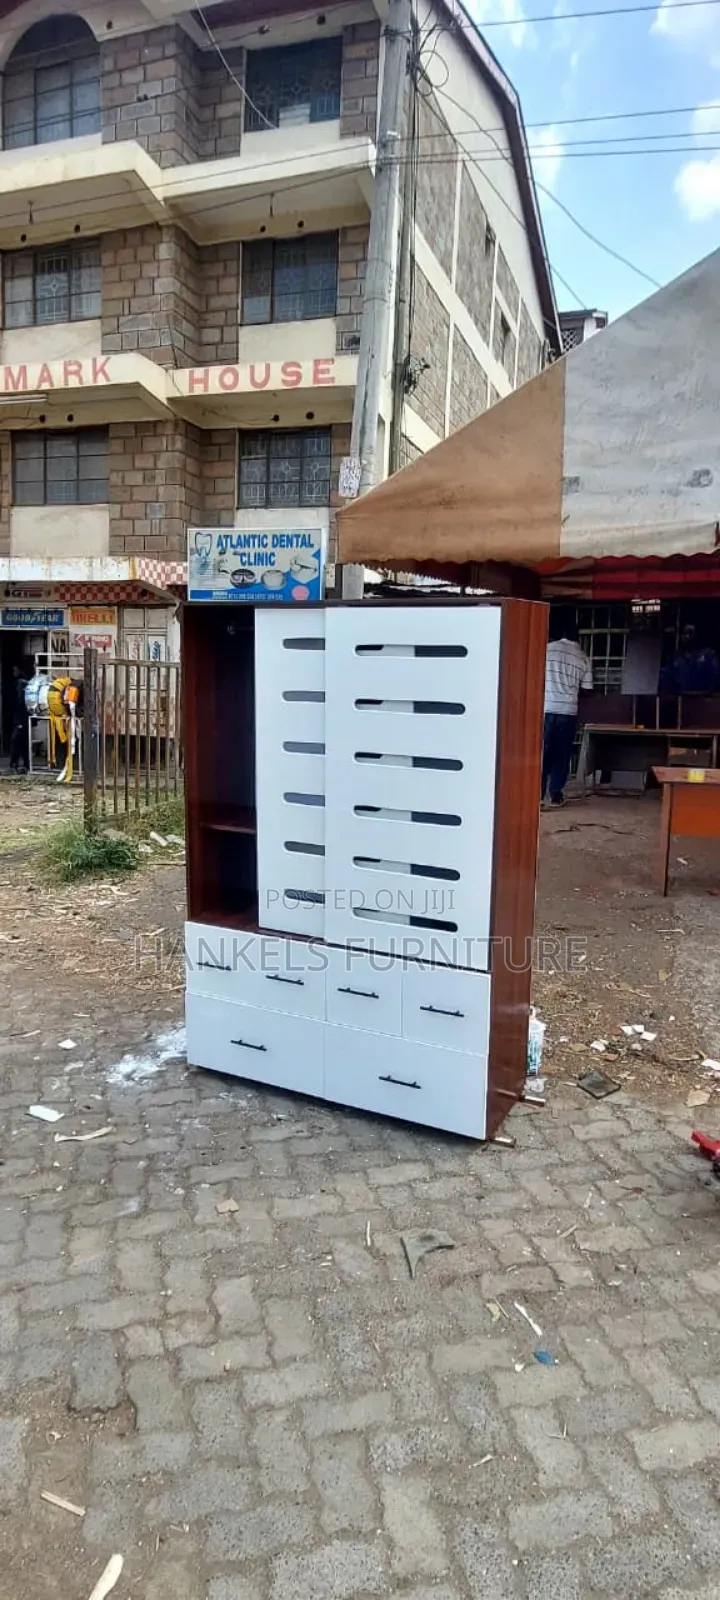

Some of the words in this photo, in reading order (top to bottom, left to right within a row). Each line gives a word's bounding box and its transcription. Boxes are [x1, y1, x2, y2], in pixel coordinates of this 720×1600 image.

[4, 356, 112, 391] MARK
[188, 357, 335, 393] HOUSE
[216, 534, 268, 549] ATLANTIC
[271, 533, 314, 549] DENTAL
[240, 551, 276, 567] CLINIC
